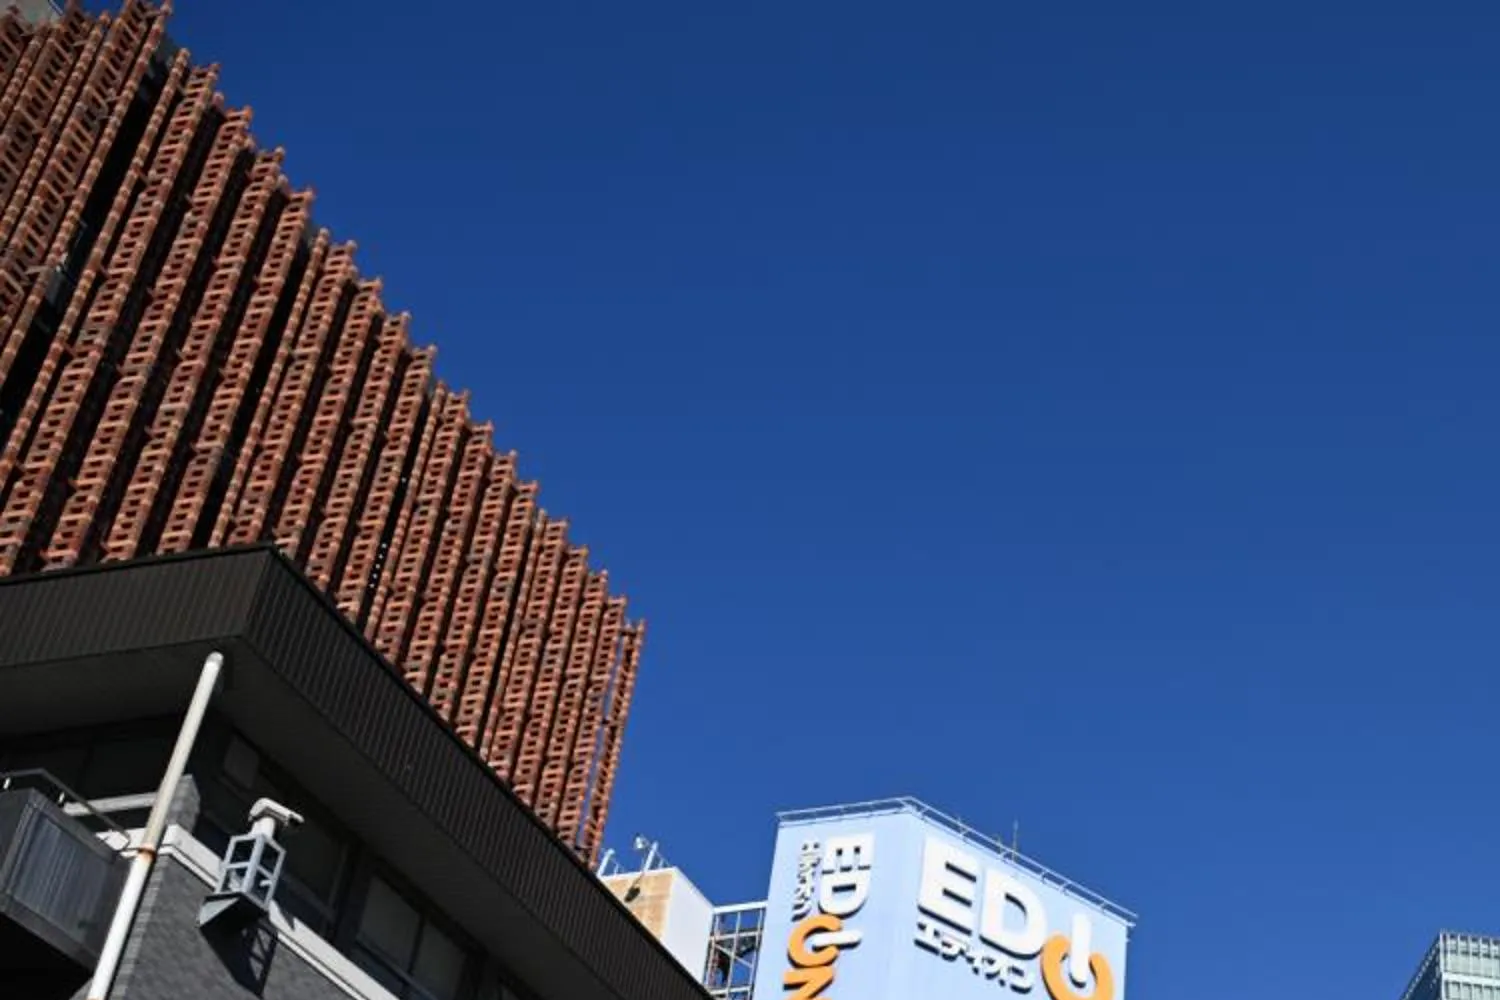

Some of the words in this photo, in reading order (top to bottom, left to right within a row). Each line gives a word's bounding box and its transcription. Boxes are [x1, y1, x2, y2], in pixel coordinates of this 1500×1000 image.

[913, 921, 1034, 995] エディオン
